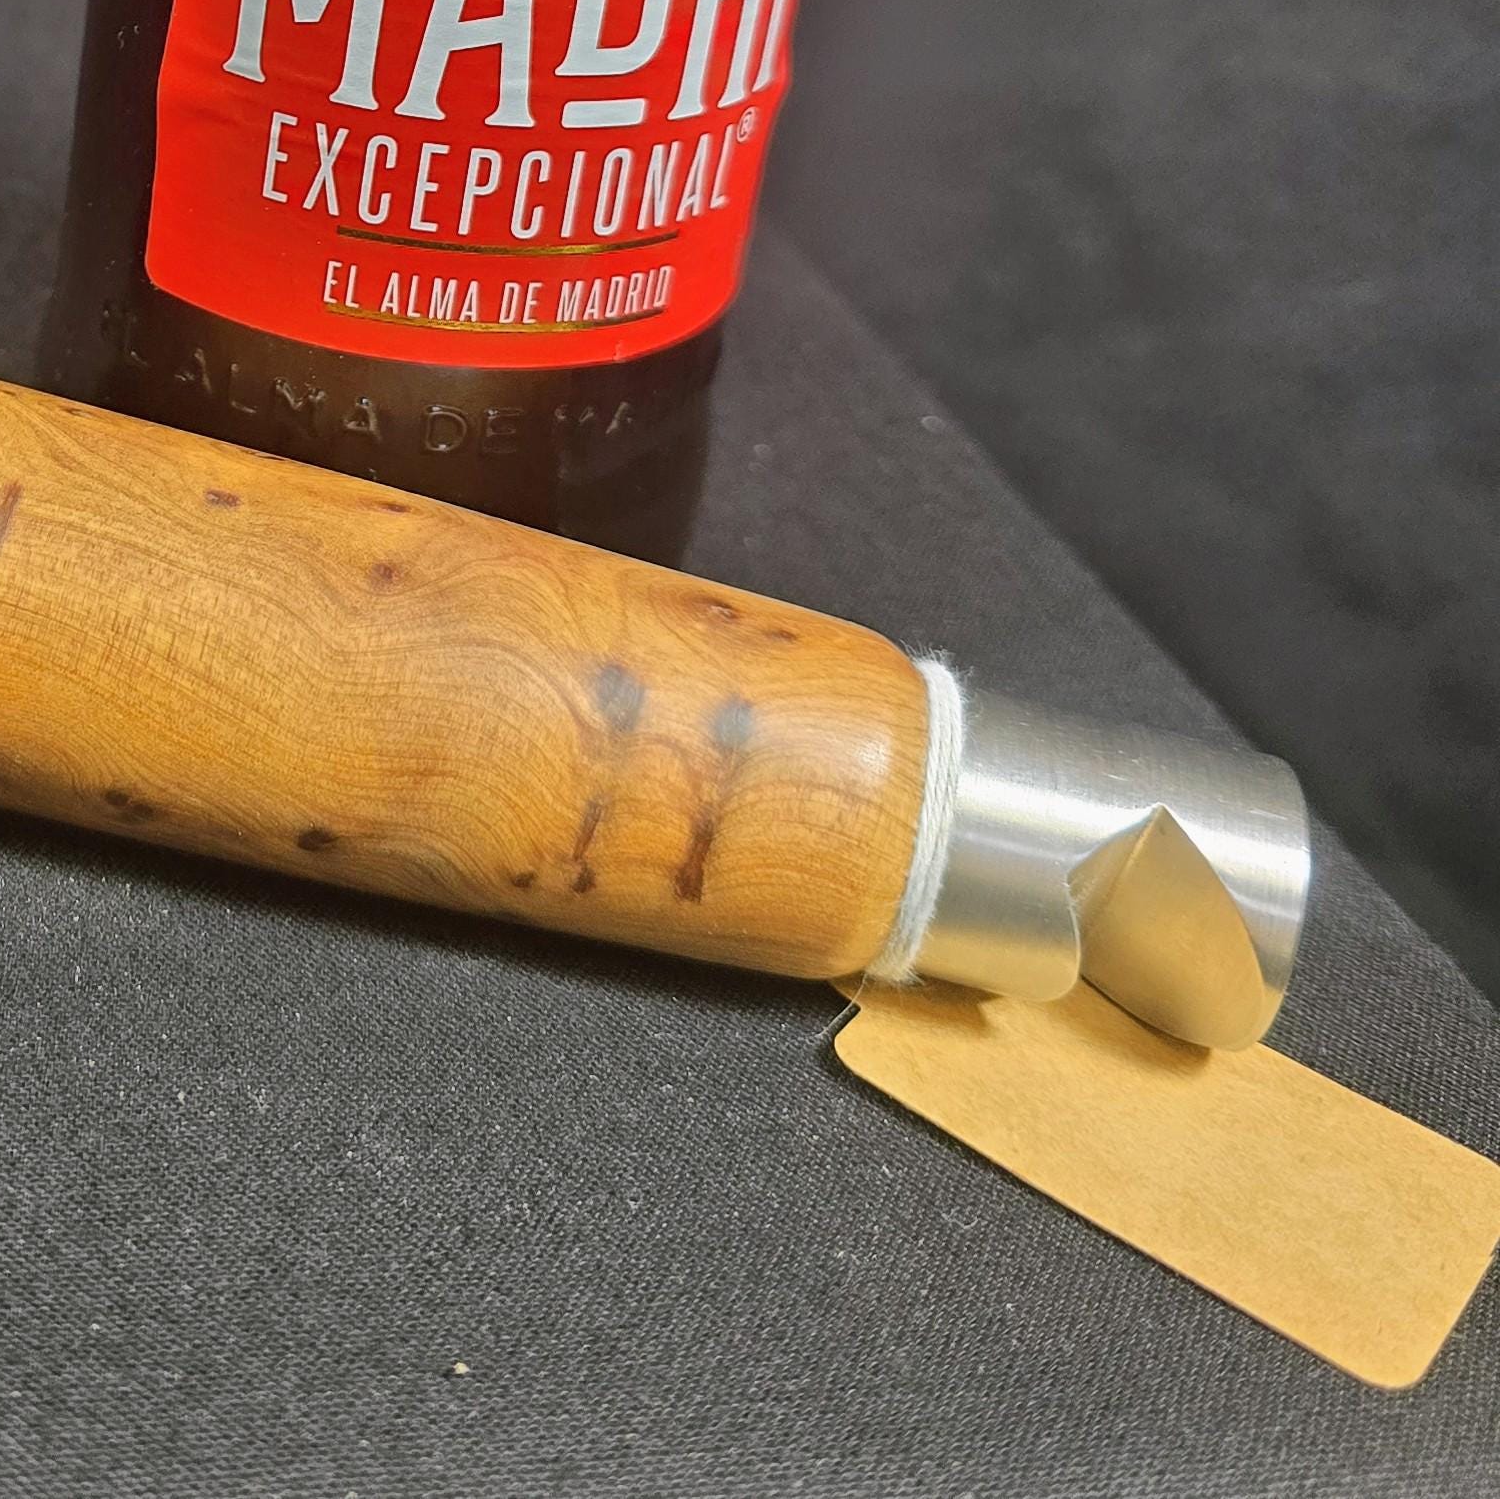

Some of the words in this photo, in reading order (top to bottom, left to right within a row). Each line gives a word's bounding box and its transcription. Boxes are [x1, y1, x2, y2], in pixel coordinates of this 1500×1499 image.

[323, 260, 361, 309] EL
[380, 271, 480, 323] ALMA
[499, 281, 542, 325] DE
[555, 264, 675, 323] MADRID
